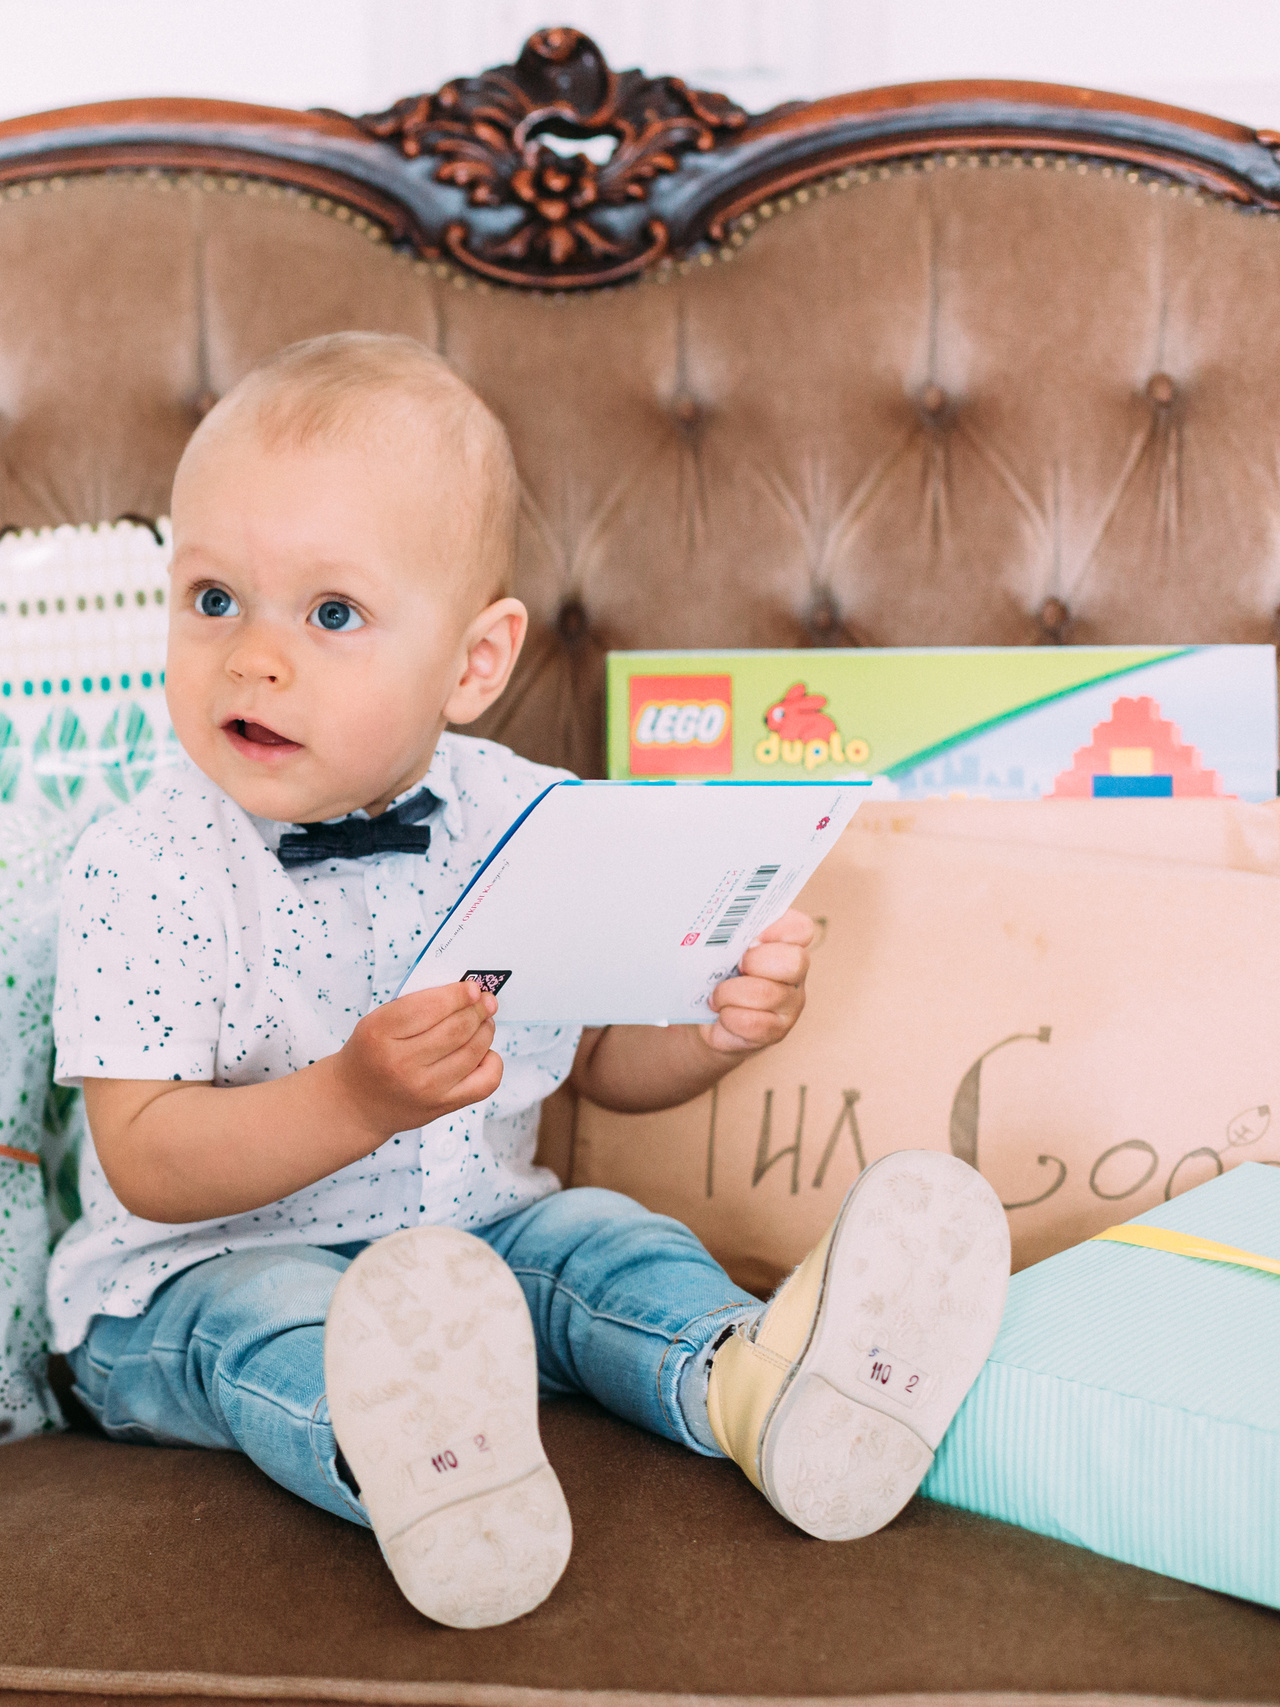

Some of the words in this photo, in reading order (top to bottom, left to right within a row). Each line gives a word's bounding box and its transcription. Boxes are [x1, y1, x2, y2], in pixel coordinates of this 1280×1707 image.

[635, 704, 727, 745] LEGO
[756, 731, 870, 770] duplo
[870, 1361, 892, 1385] 110
[904, 1374, 920, 1393] 2
[431, 1449, 459, 1473] 110
[473, 1433, 490, 1452] 2
